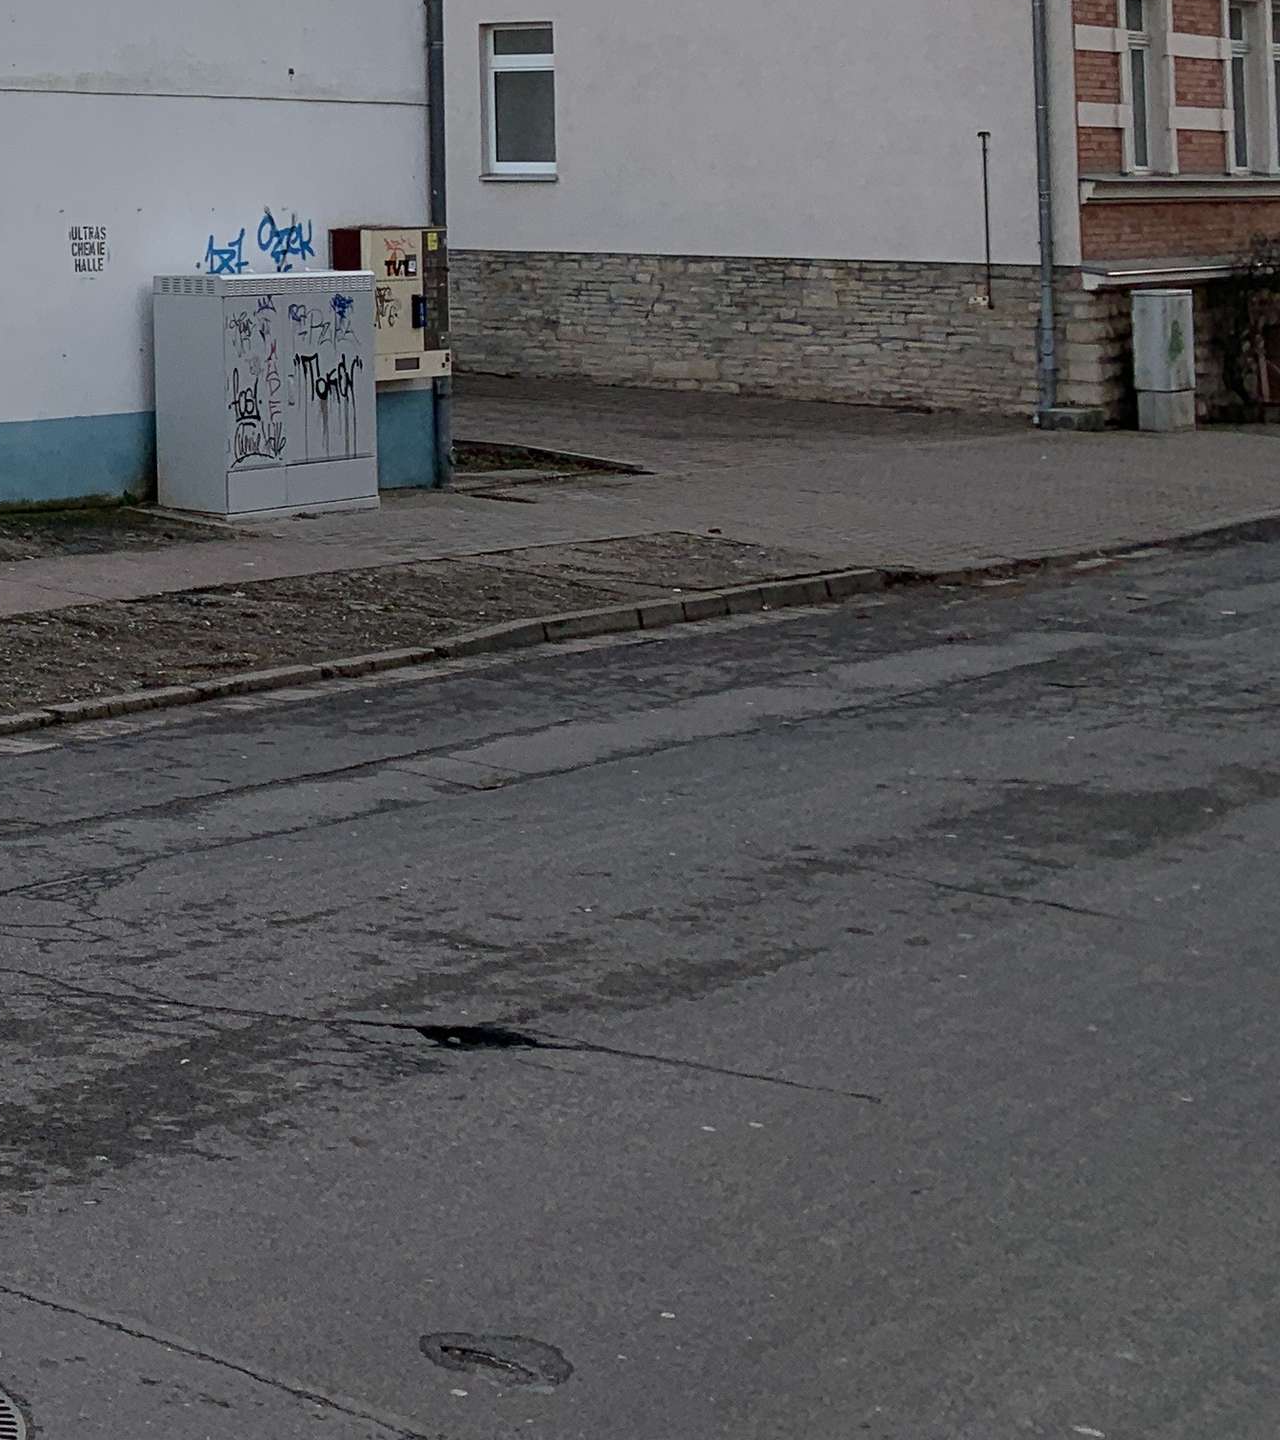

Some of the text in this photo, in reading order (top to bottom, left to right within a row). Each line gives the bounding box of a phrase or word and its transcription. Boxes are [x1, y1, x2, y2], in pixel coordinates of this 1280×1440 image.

[71, 226, 106, 240] ULTRAS
[71, 242, 105, 256] CHEMIE
[74, 258, 104, 272] HALLE
